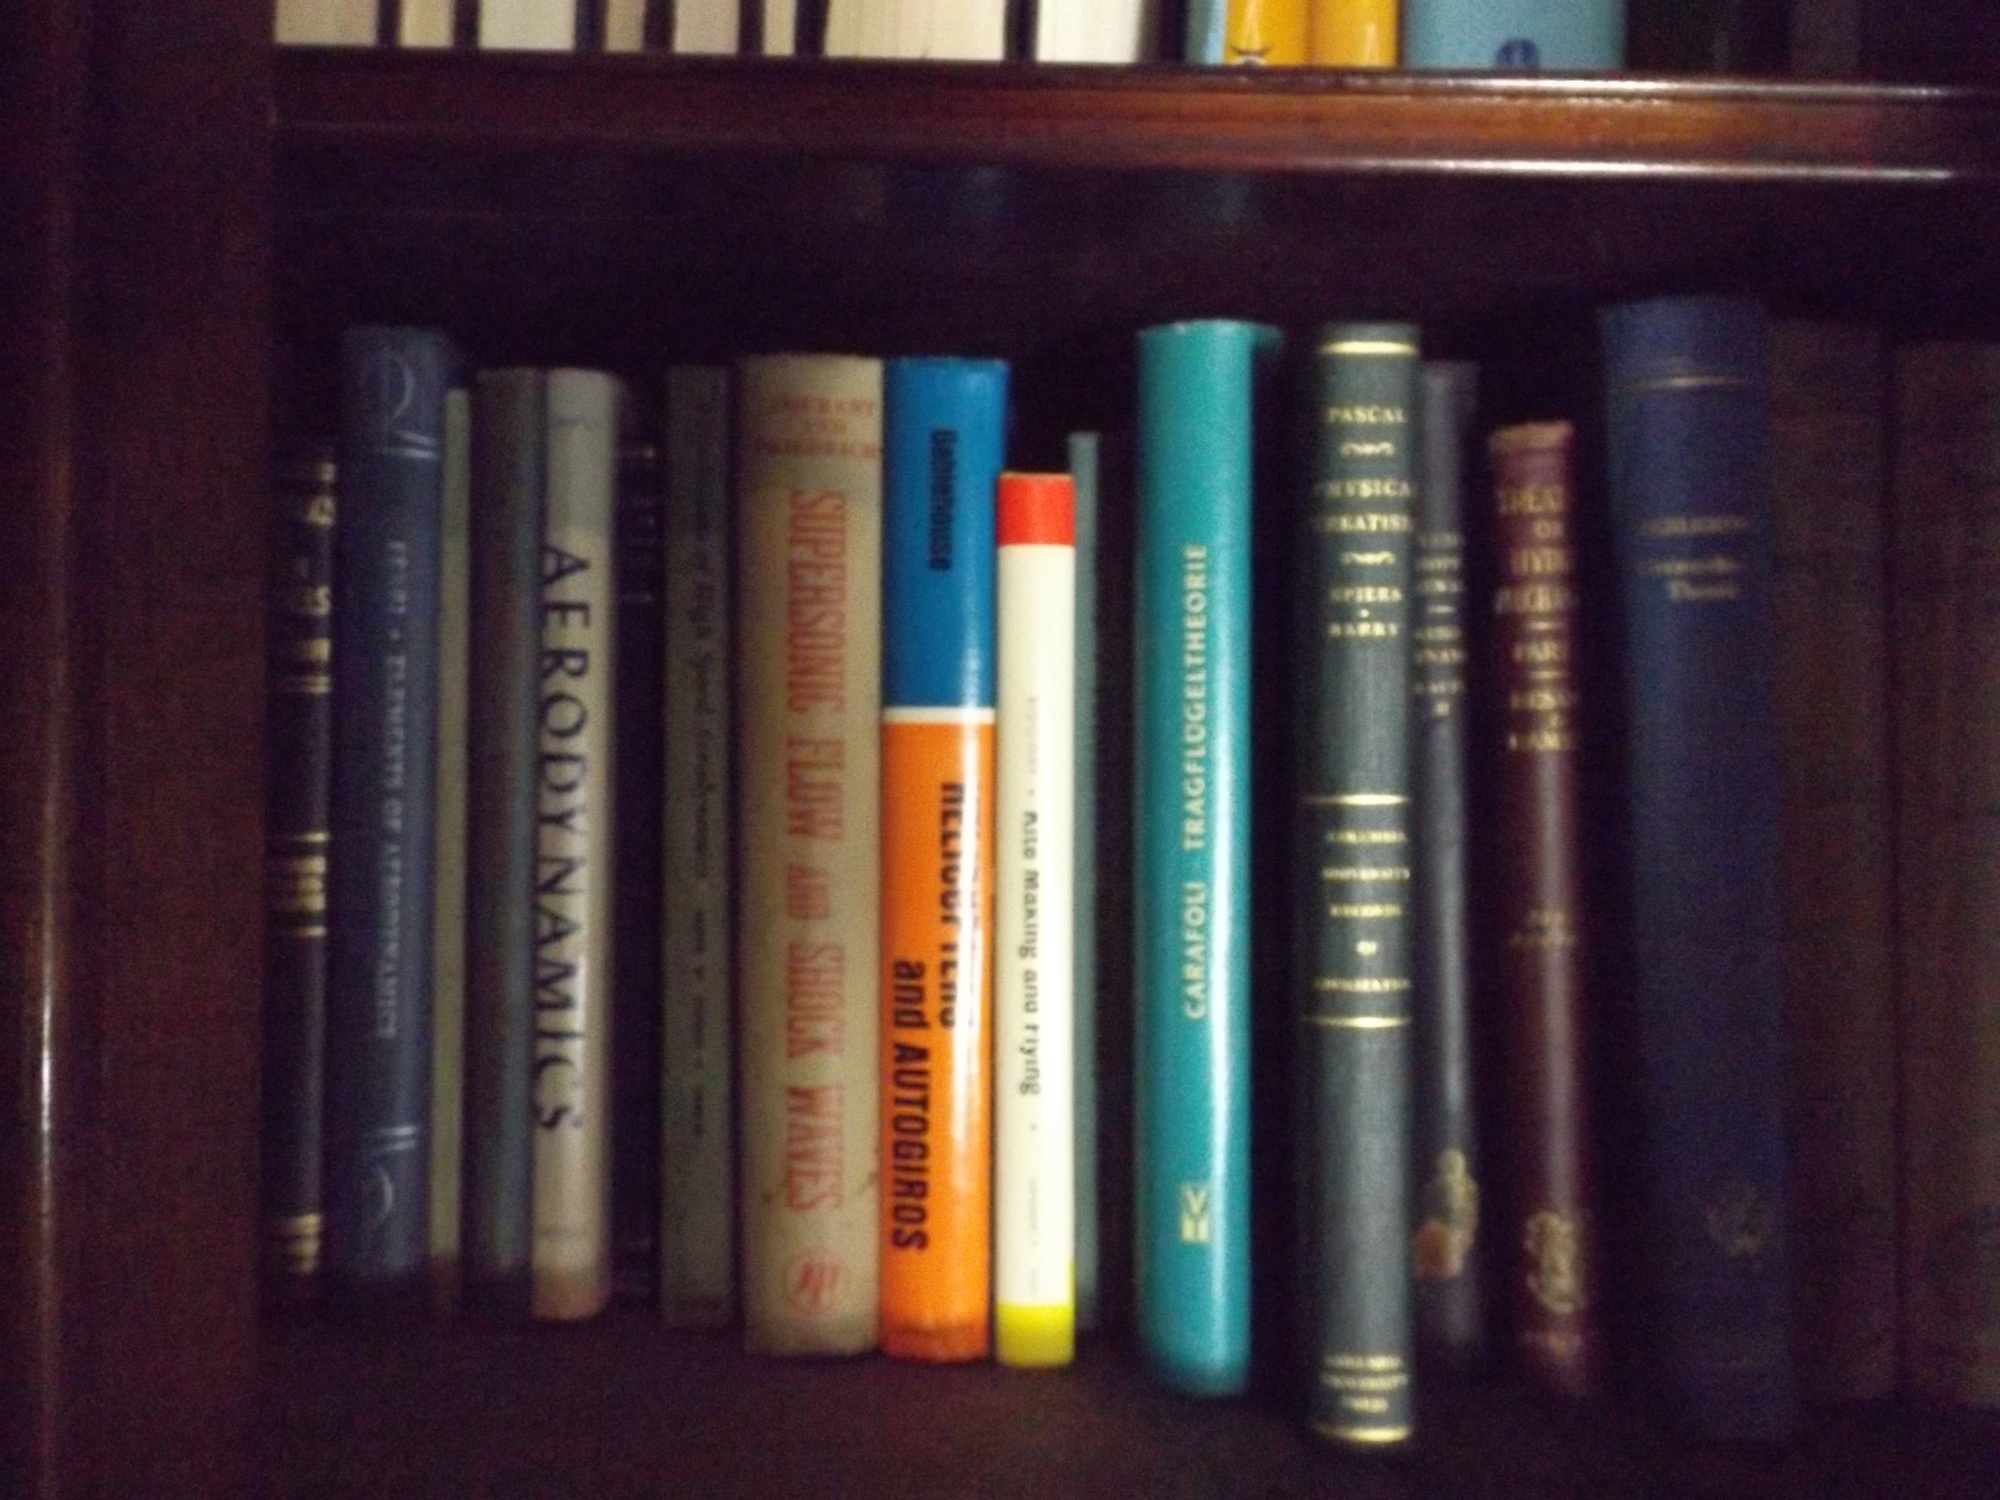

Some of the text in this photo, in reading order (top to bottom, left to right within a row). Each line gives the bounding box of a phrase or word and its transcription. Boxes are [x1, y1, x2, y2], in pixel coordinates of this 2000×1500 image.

[1327, 404, 1407, 424] PASCAL
[786, 489, 847, 714] SUPERSONIC
[532, 543, 592, 1132] AERODYNAMICS
[786, 736, 847, 841] FLOW
[787, 864, 832, 920] AND
[1018, 870, 1039, 959] Making
[786, 943, 847, 1060] SHOCK
[1020, 970, 1039, 1013] and
[1182, 881, 1206, 1021] CARAFOLI
[892, 960, 929, 1252] and AUTOGIROS
[1018, 1024, 1039, 1096] Flying
[786, 1085, 847, 1210] WAVES
